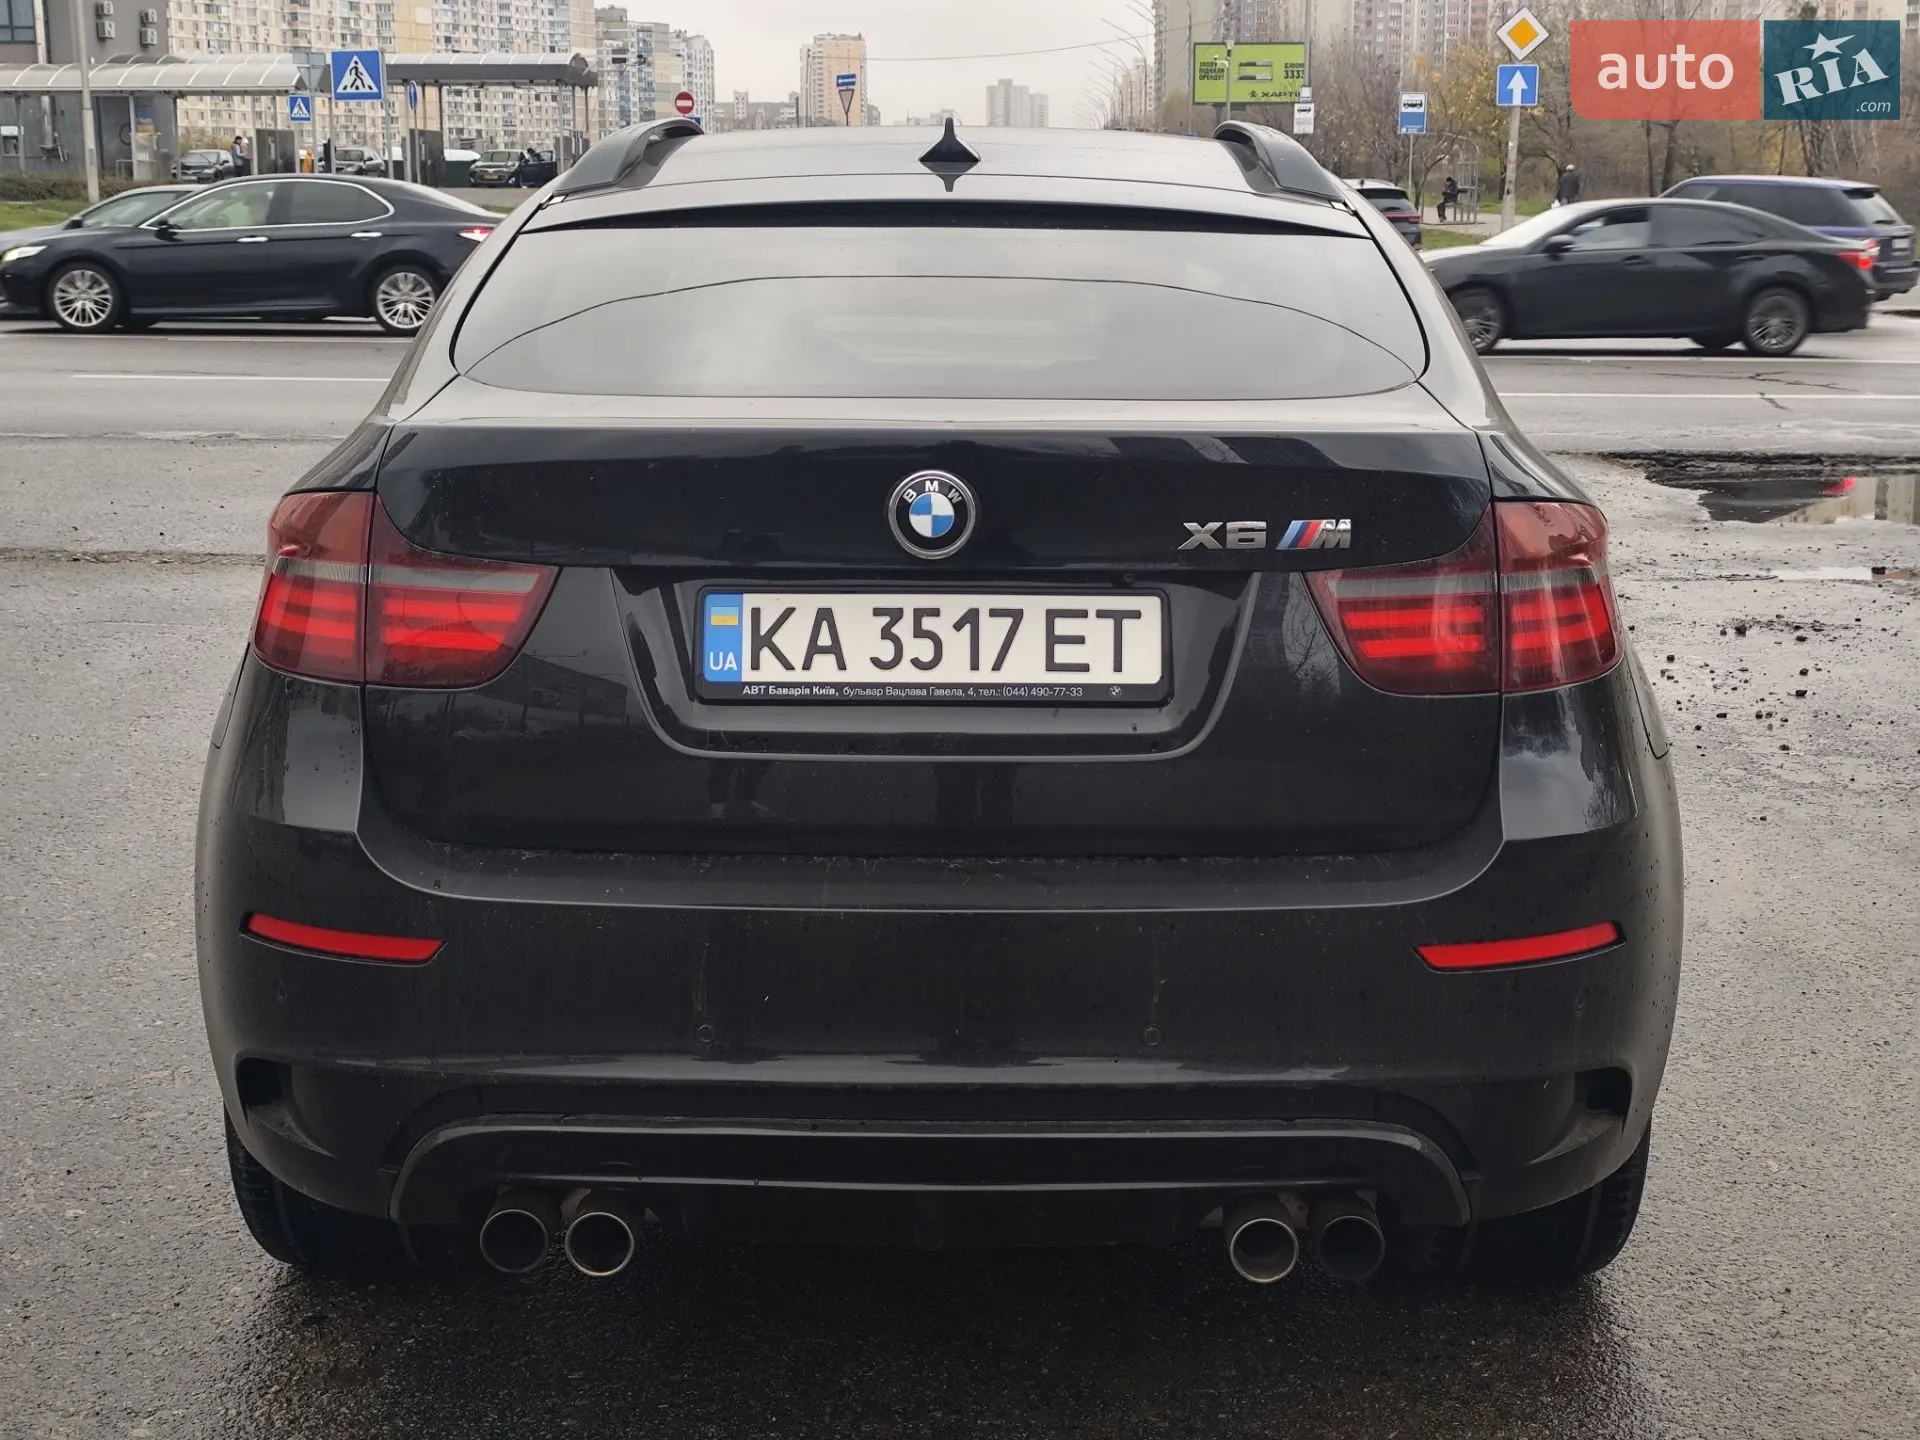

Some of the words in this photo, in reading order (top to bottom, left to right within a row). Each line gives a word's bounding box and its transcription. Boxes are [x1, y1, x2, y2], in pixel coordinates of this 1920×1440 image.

[902, 480, 963, 504] BMW
[1178, 521, 1267, 551] X6
[750, 606, 847, 671] KA
[870, 607, 1024, 672] 3517
[1045, 608, 1142, 673] ET
[709, 651, 738, 671] UA
[742, 685, 766, 696] АВТ
[768, 685, 811, 697] Баварія
[812, 685, 839, 698] Київ,
[842, 685, 884, 698] бульвар
[885, 685, 928, 698] Вацлава
[929, 686, 966, 699] Гавела,
[967, 686, 977, 699] 4,
[978, 687, 1001, 697] тел.:
[1002, 686, 1029, 699] (044)
[1030, 686, 1084, 698] 490-77-33
